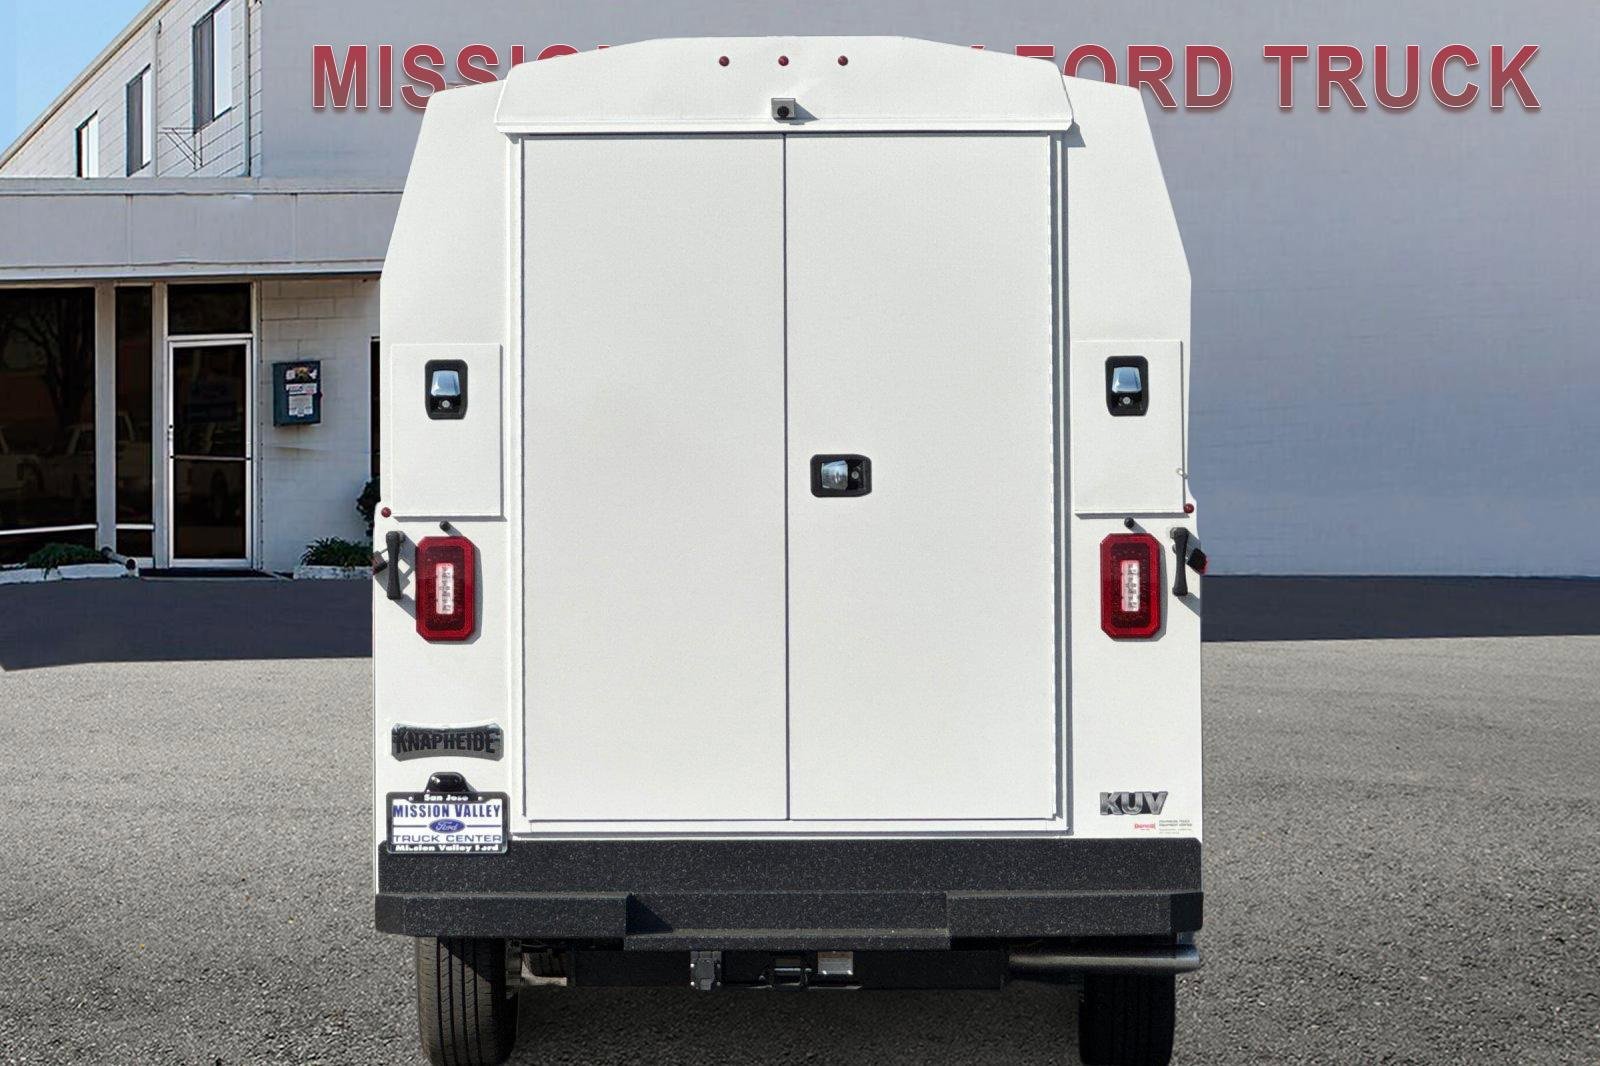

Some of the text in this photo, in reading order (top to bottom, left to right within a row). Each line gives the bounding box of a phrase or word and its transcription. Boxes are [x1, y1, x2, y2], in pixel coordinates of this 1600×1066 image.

[312, 43, 1541, 109] MISS ORD TRUCK
[393, 725, 502, 755] KNAPHEIDE
[1099, 791, 1168, 815] KUV
[392, 804, 501, 818] MISSION VALLEY
[435, 821, 459, 831] Ford
[394, 835, 502, 843] TRUCK CENTER
[438, 844, 472, 853] Valley
